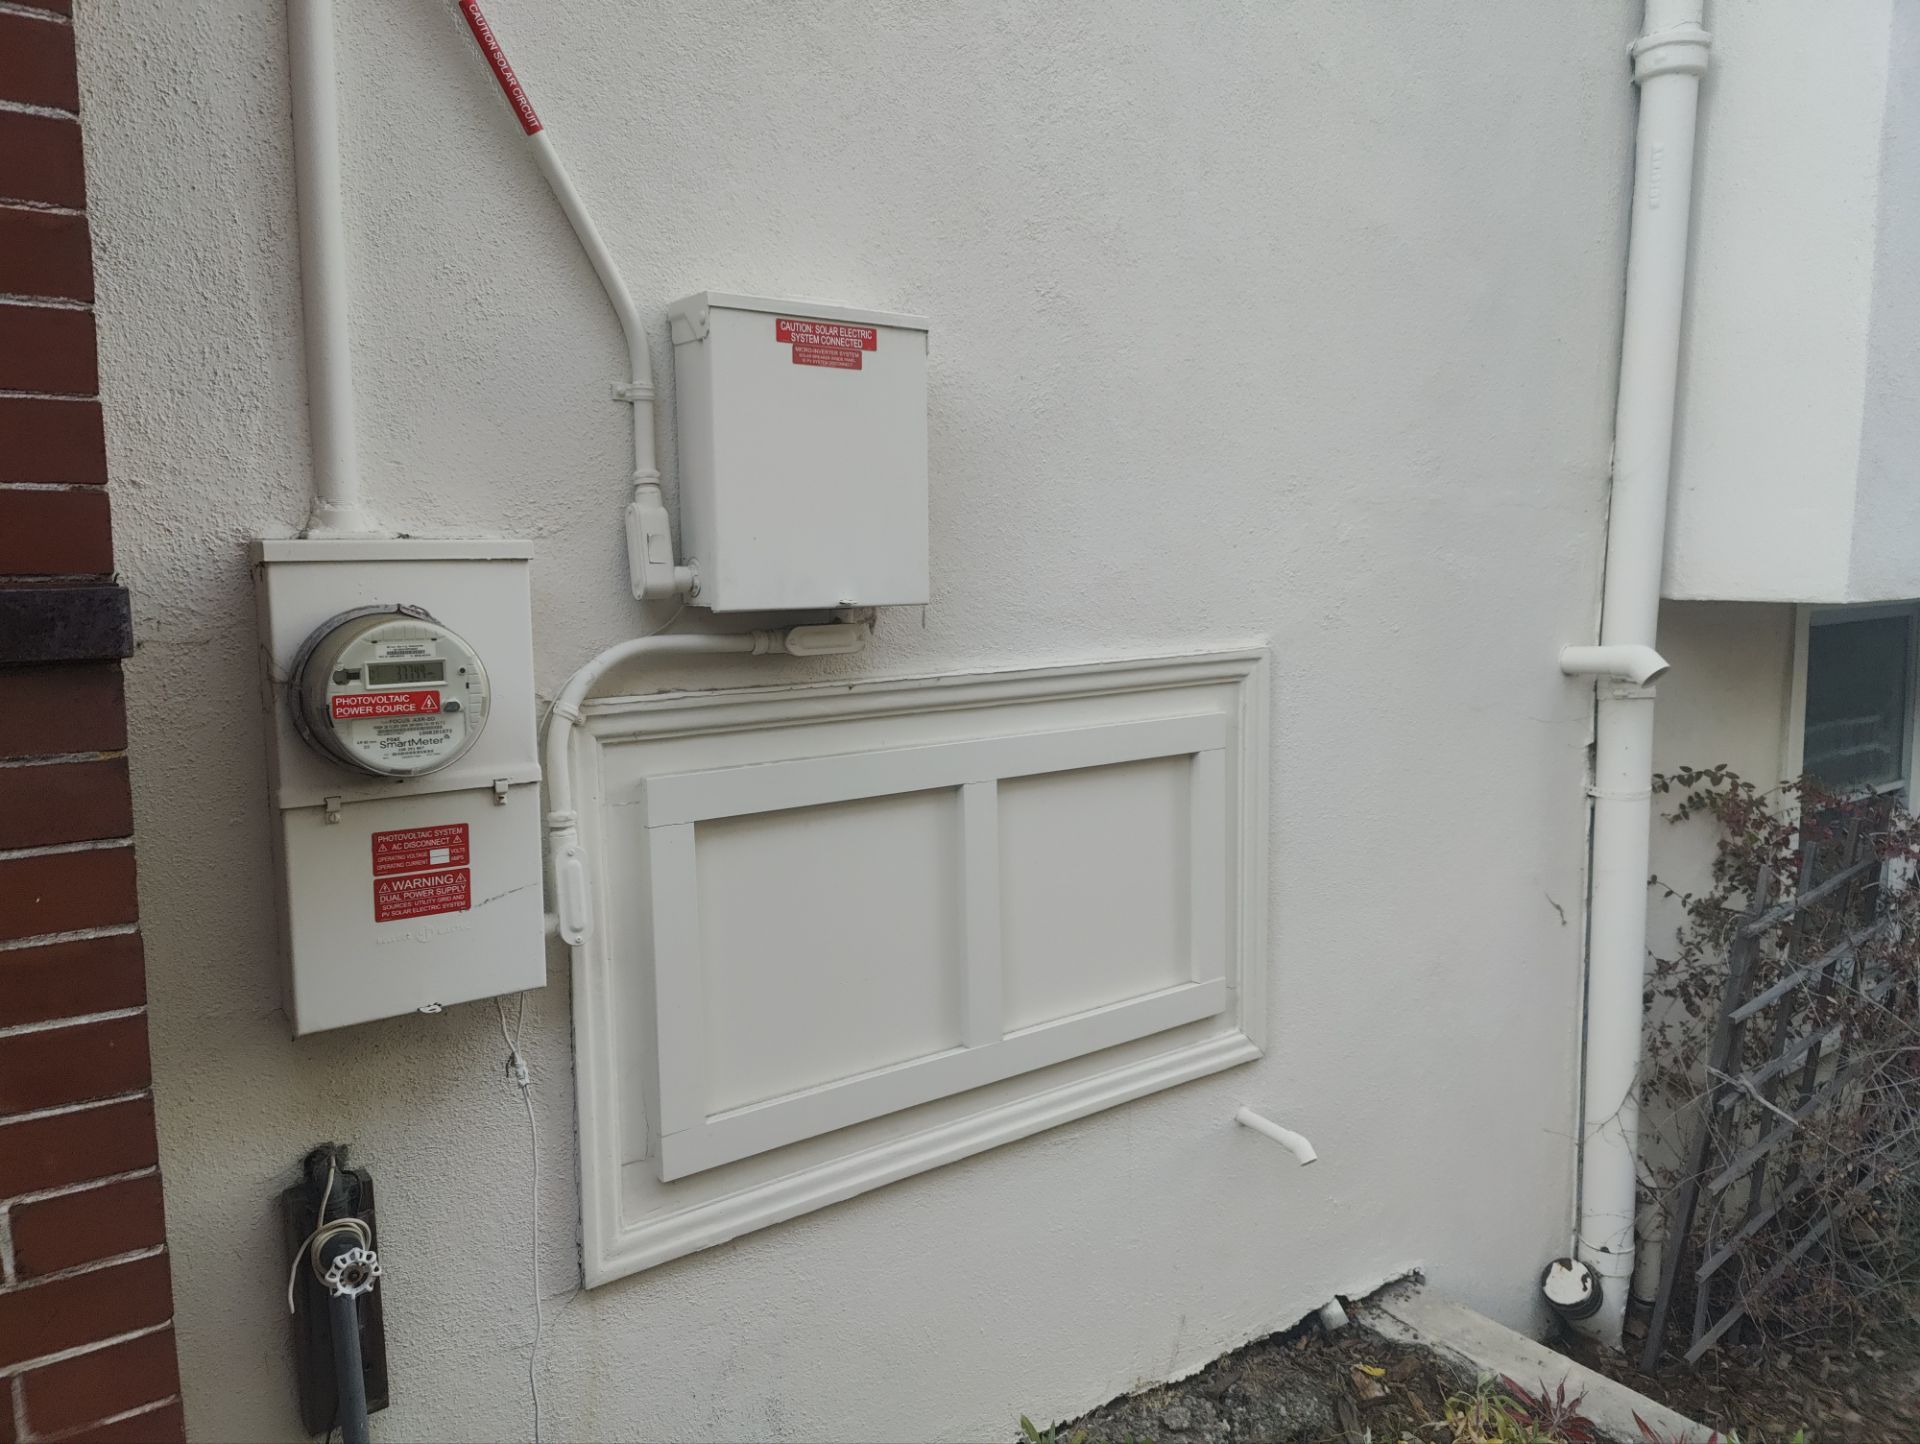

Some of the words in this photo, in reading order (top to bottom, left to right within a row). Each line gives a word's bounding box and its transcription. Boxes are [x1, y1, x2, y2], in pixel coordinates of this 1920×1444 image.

[469, 4, 498, 51] CAUTION
[493, 51, 517, 87] SOLAR
[512, 87, 539, 127] CIRCUIT
[780, 321, 814, 333] CAUTION:
[815, 325, 838, 336] SOLAR
[839, 327, 873, 340] ELECTRIC
[791, 332, 820, 344] SYSTEM
[820, 335, 863, 348] CONNECTED
[335, 694, 410, 706] PHOTOVOLTAIC
[336, 706, 373, 715] POWER
[375, 703, 416, 714] SOURCE
[380, 738, 443, 749] SmartMeter
[377, 831, 433, 843] PHOTOVOLTAIC
[434, 827, 463, 837] SYSTEM
[403, 837, 450, 850] DISCONNECT
[377, 854, 406, 863] OPERATING
[377, 862, 405, 871] OPERATING
[405, 859, 428, 867] CURRENT
[391, 874, 454, 891] WARNING
[379, 894, 402, 903] DUAL
[403, 889, 434, 900] POWER
[436, 884, 466, 895] SUPPLY
[391, 908, 412, 917] SOLAR
[412, 904, 441, 913] ELECTRIC
[442, 901, 466, 909] SYSTEM
[414, 898, 436, 906] UTILITY
